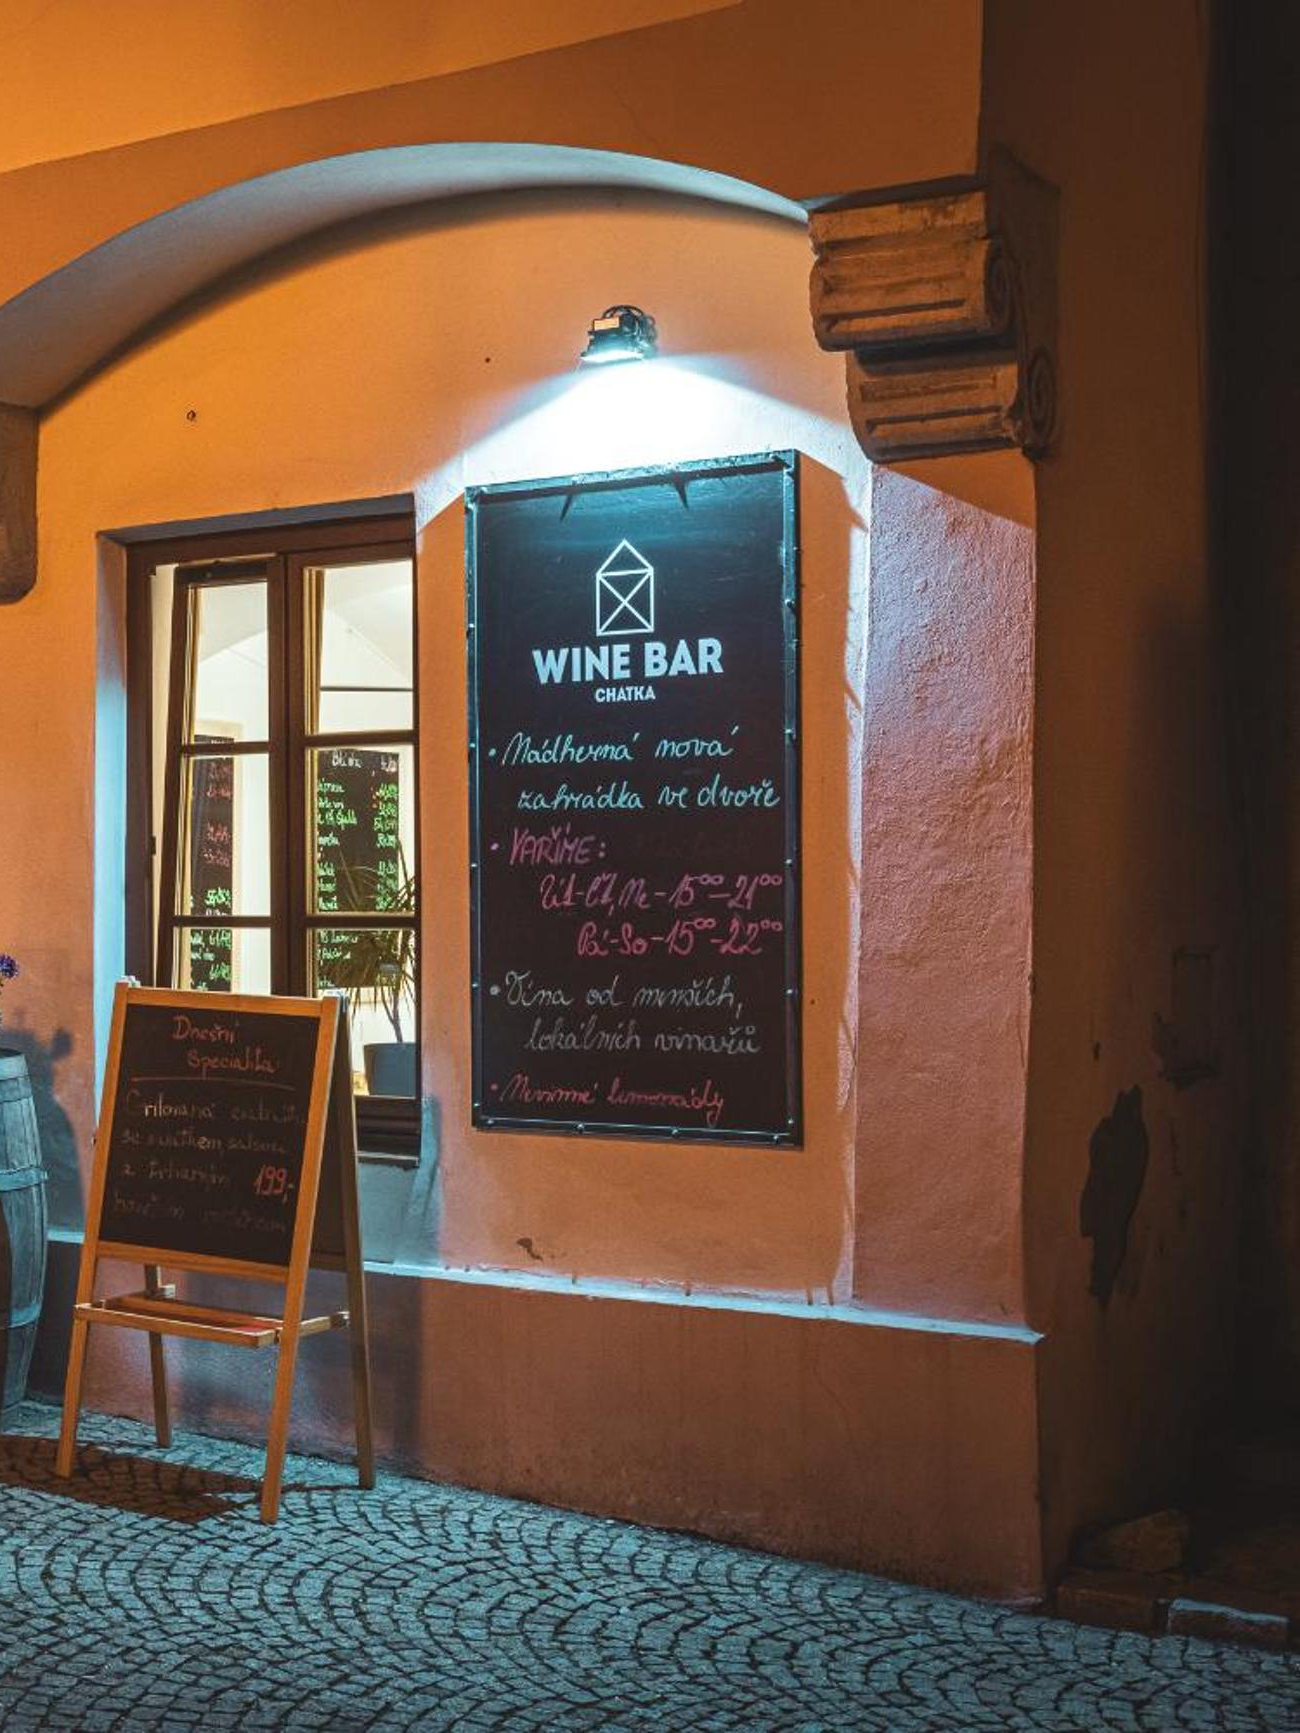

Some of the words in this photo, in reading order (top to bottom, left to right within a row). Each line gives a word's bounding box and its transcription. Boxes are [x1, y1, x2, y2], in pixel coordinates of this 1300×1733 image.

[531, 643, 631, 684] WINE
[644, 638, 723, 677] BAR
[595, 686, 656, 702] CHATKA
[655, 726, 739, 760] nová
[517, 781, 645, 810] zahrádka
[697, 773, 781, 808] dvoře
[505, 970, 574, 1007] Vína
[586, 974, 623, 1007] od
